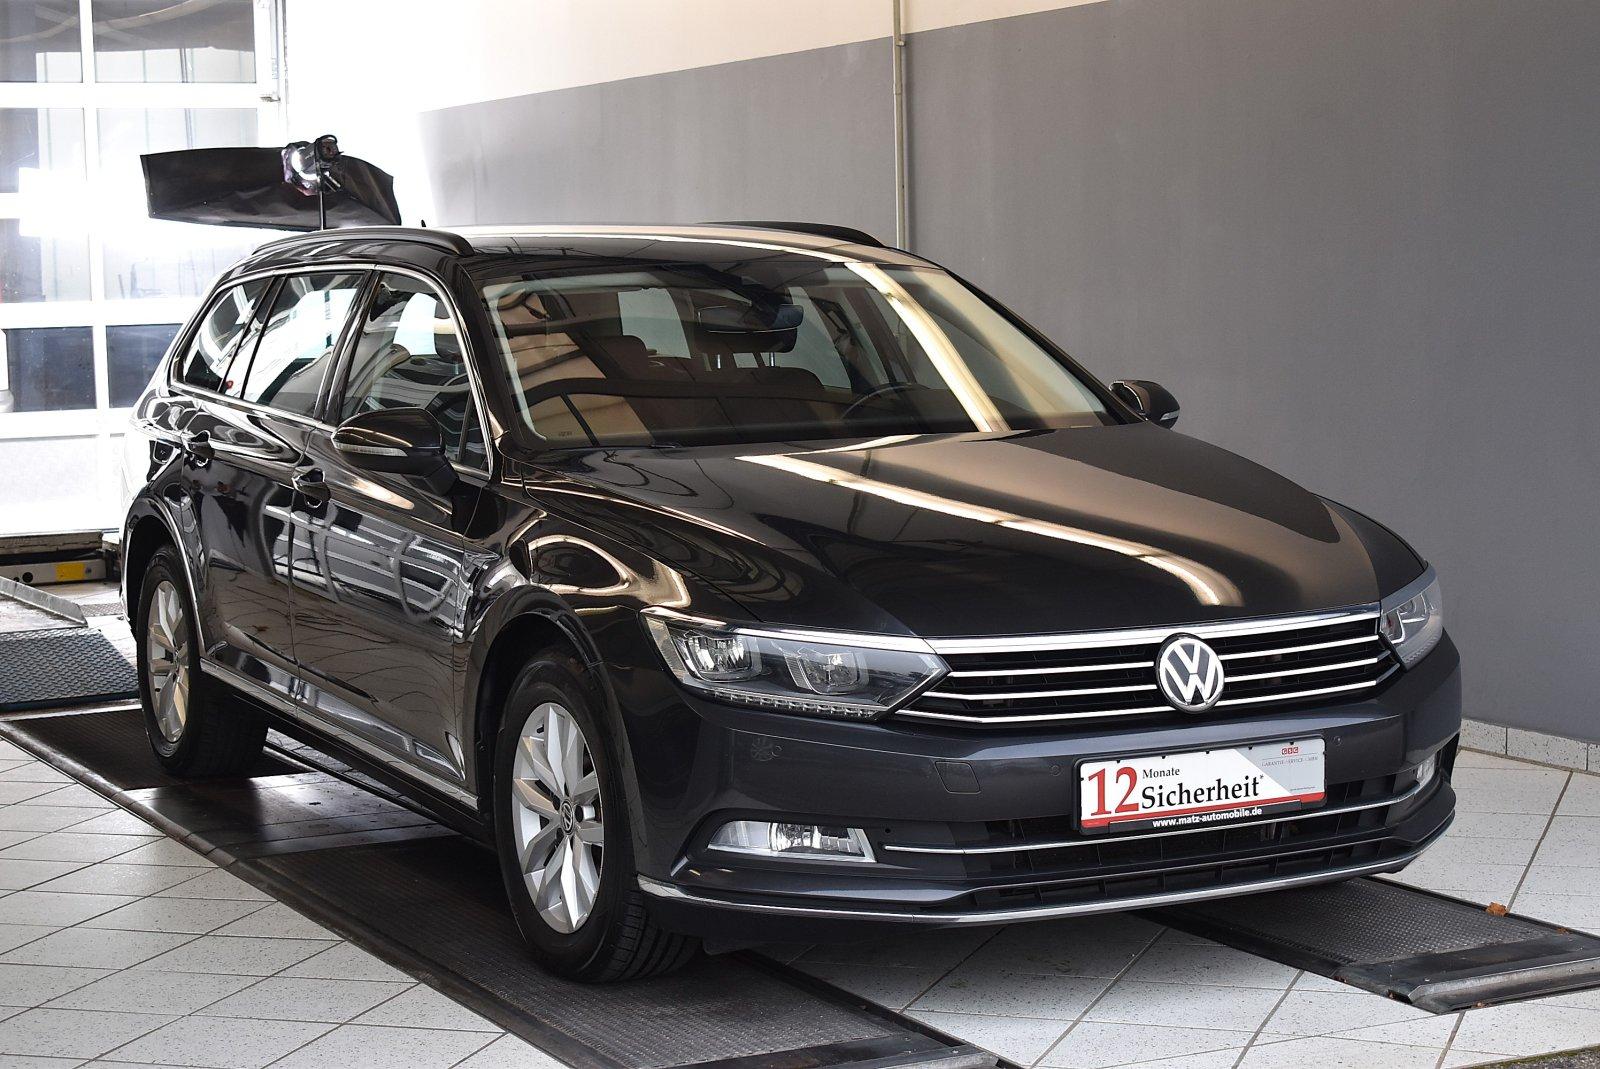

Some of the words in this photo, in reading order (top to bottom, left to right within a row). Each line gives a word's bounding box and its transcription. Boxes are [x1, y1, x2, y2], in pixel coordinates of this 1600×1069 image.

[1142, 767, 1180, 779] Monate
[1088, 766, 1139, 816] 12
[1152, 807, 1263, 828] www.matz-automobile.de
